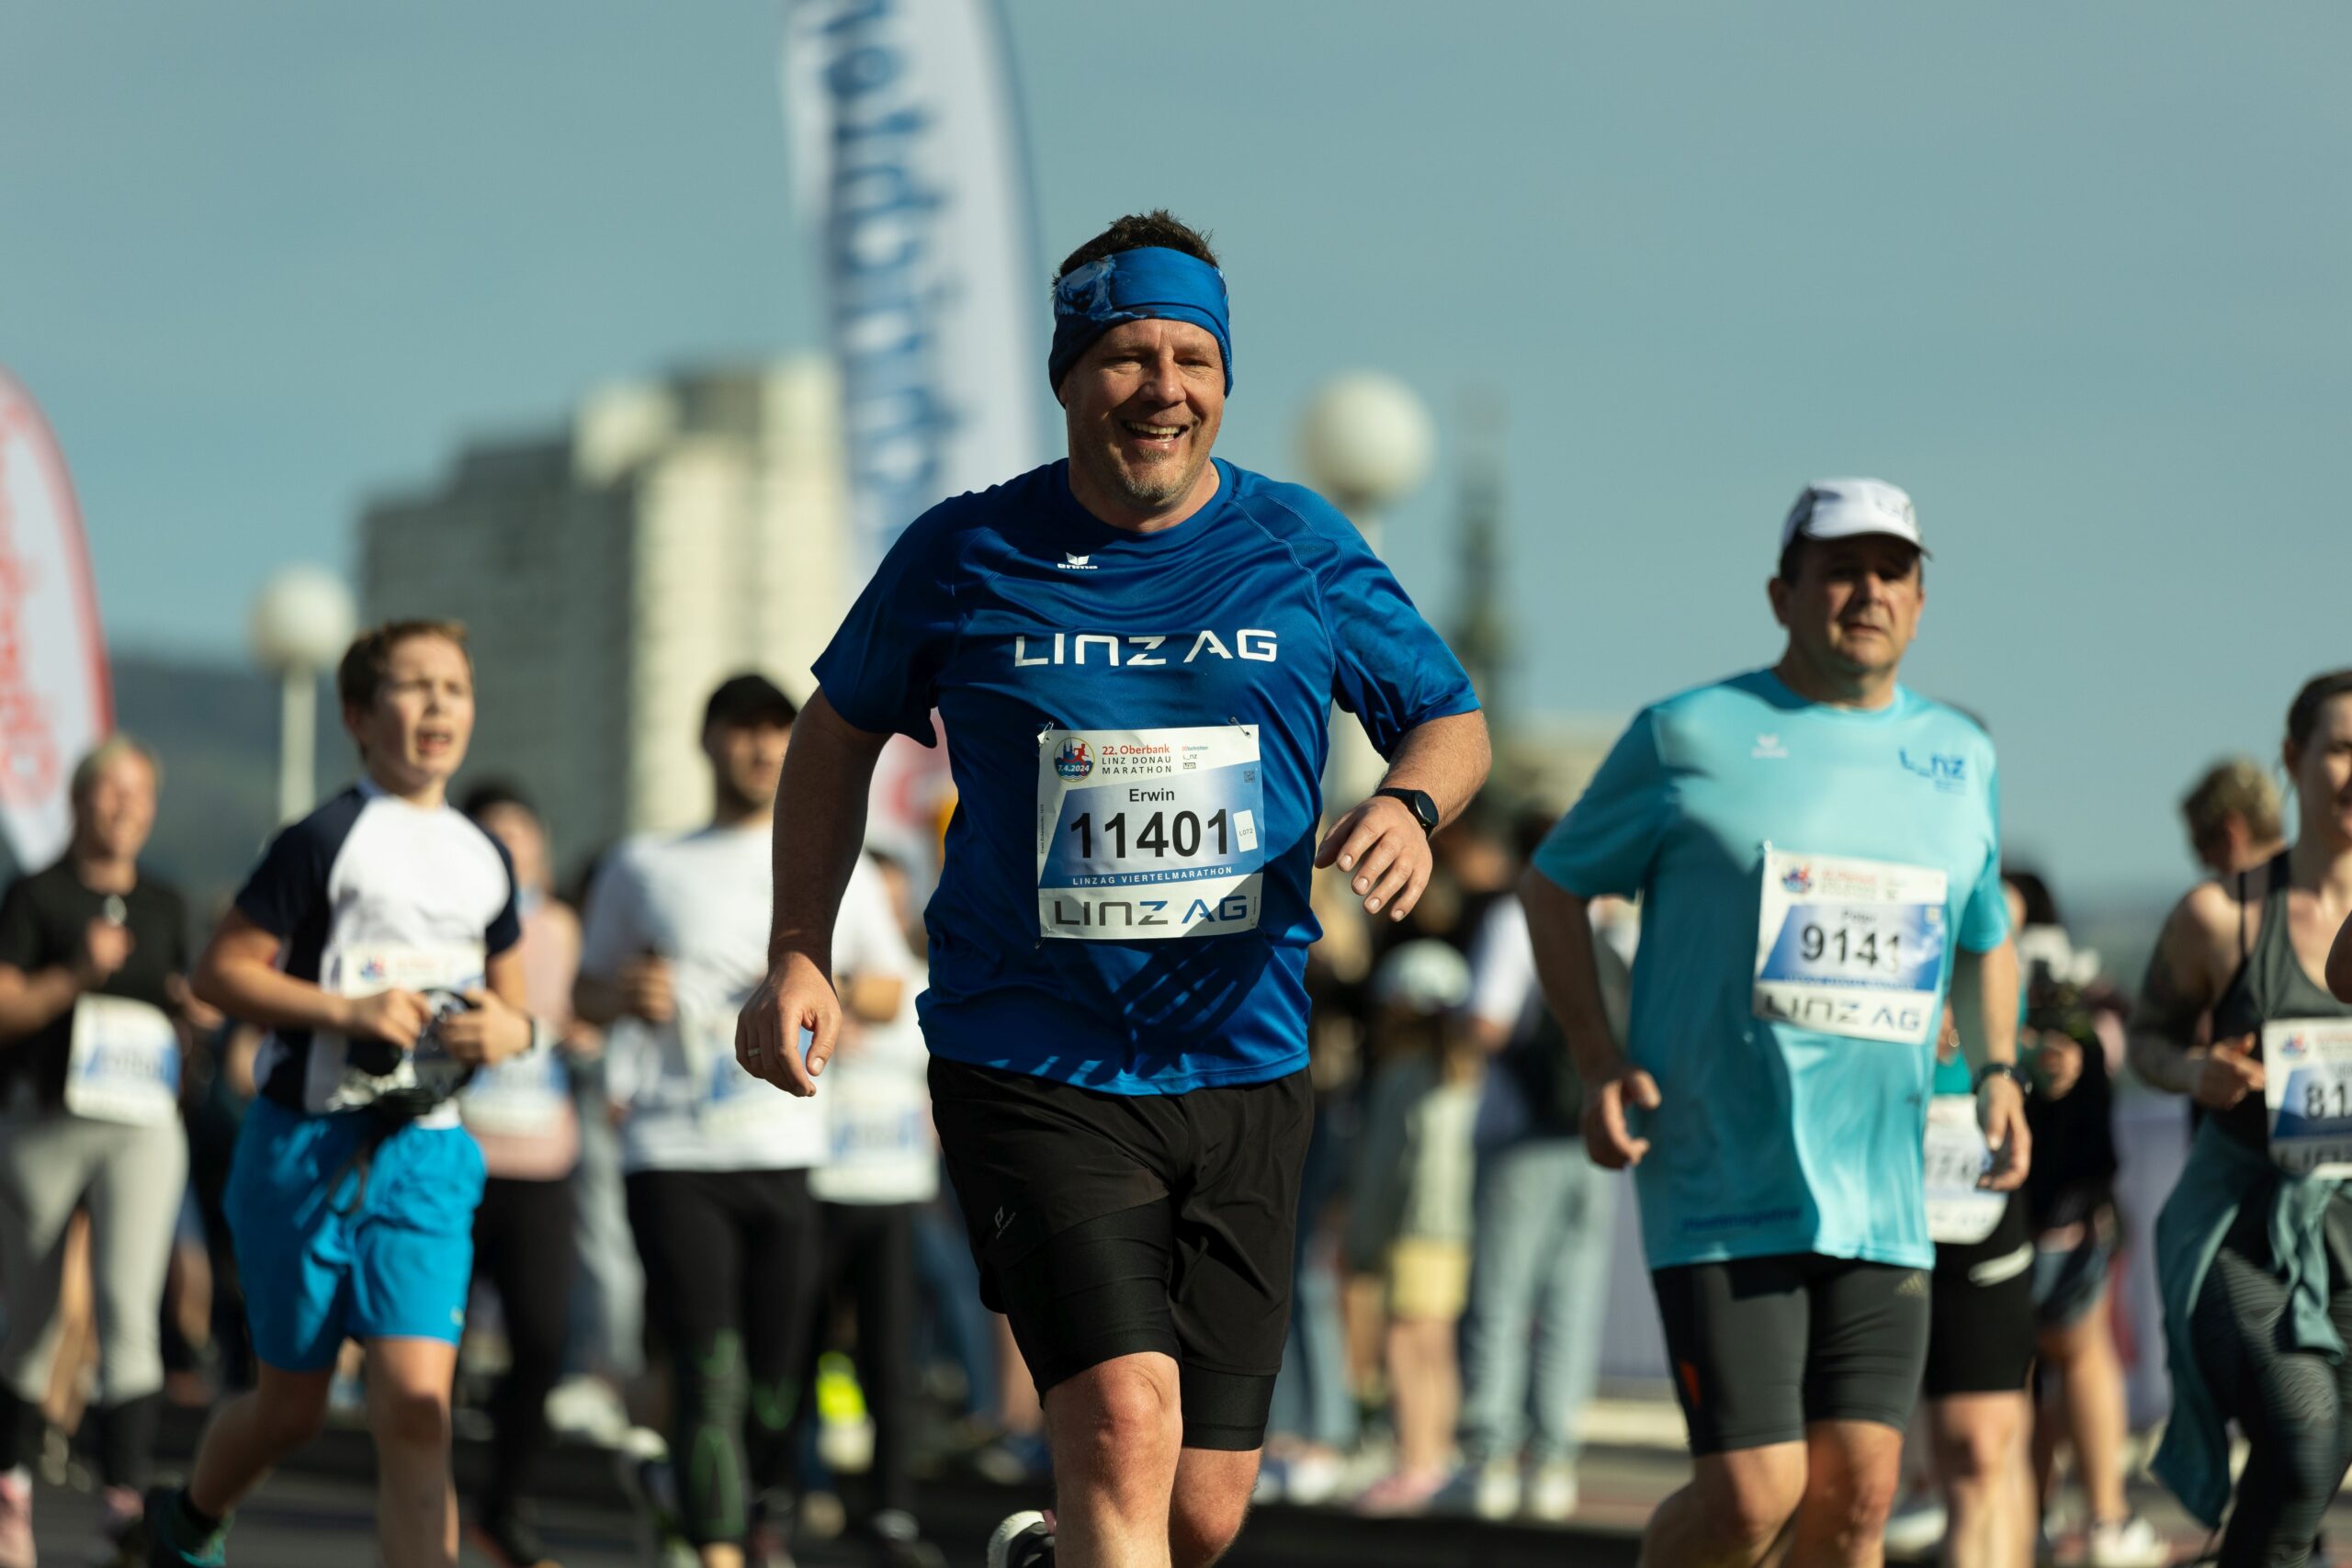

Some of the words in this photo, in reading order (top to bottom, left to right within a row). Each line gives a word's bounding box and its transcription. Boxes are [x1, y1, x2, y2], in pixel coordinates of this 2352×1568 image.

[1014, 633, 1167, 667] LINZ
[1182, 629, 1278, 663] AG
[1102, 746, 1117, 755] 22.
[1119, 744, 1170, 755] Oberbank
[1057, 763, 1091, 773] 7.4.2024
[1102, 756, 1126, 765] LINZ
[1132, 756, 1171, 764] DONAU
[1102, 765, 1172, 775] MARATHON
[1128, 787, 1175, 803] Erwin
[1070, 808, 1227, 859] 11401
[1121, 866, 1232, 883] VIERTELMARATHON
[1054, 900, 1169, 927] LINZ
[1181, 895, 1248, 924] AG
[1871, 1006, 1923, 1032] AG
